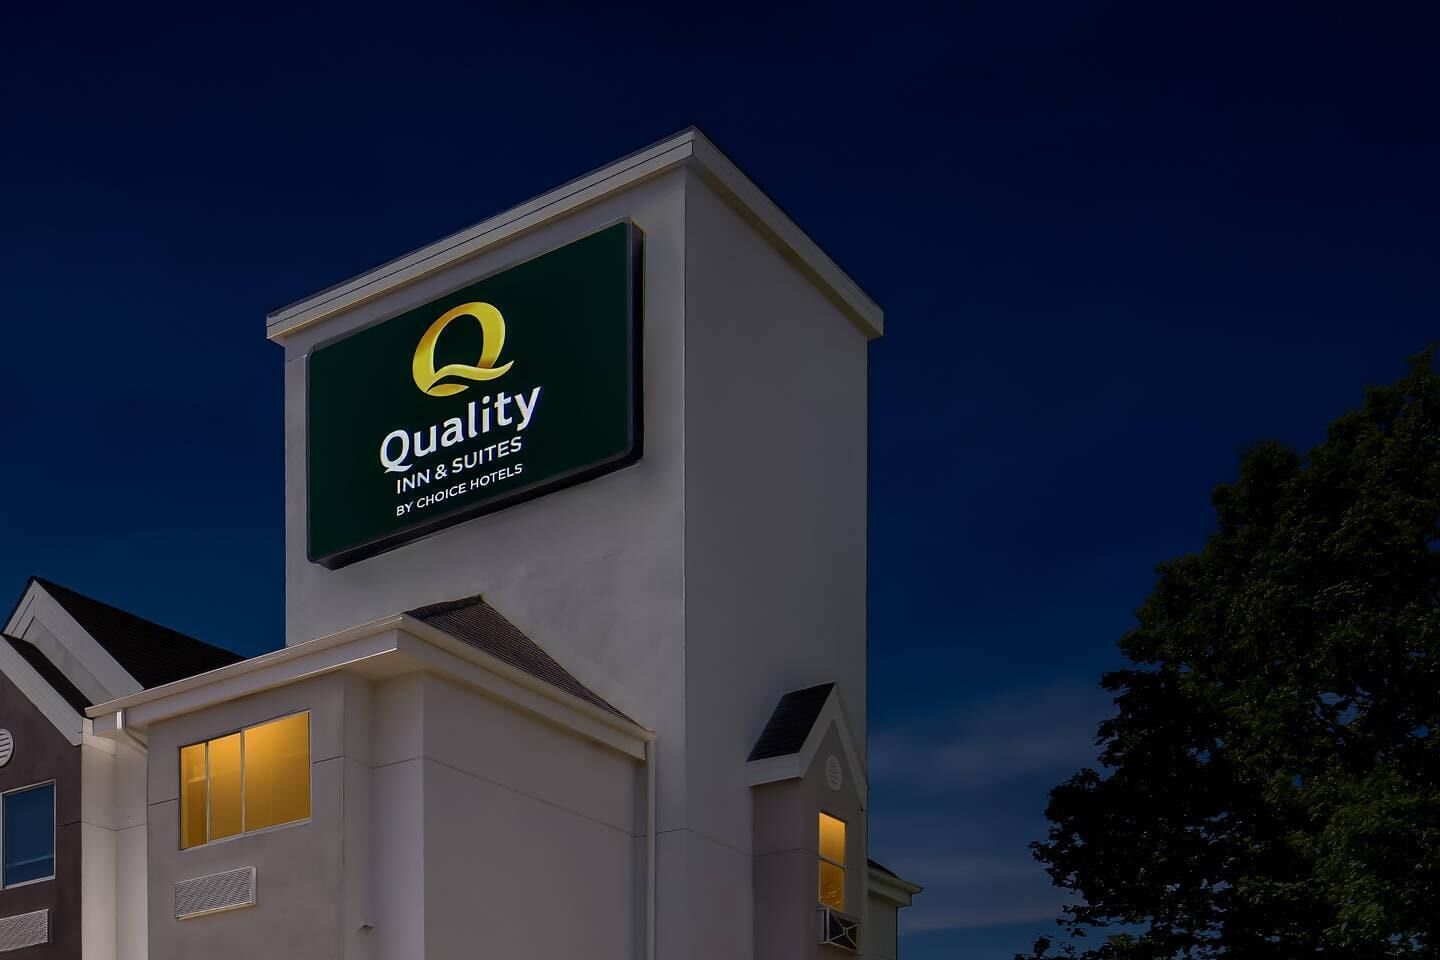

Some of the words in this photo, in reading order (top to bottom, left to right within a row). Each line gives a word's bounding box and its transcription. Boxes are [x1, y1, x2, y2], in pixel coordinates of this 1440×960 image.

[379, 386, 542, 474] Quality
[395, 501, 414, 517] BY
[416, 482, 467, 509] CHOICE
[470, 463, 523, 490] HOTELS
[396, 468, 431, 495] INN
[434, 463, 448, 480] &
[451, 435, 523, 474] SUITES
